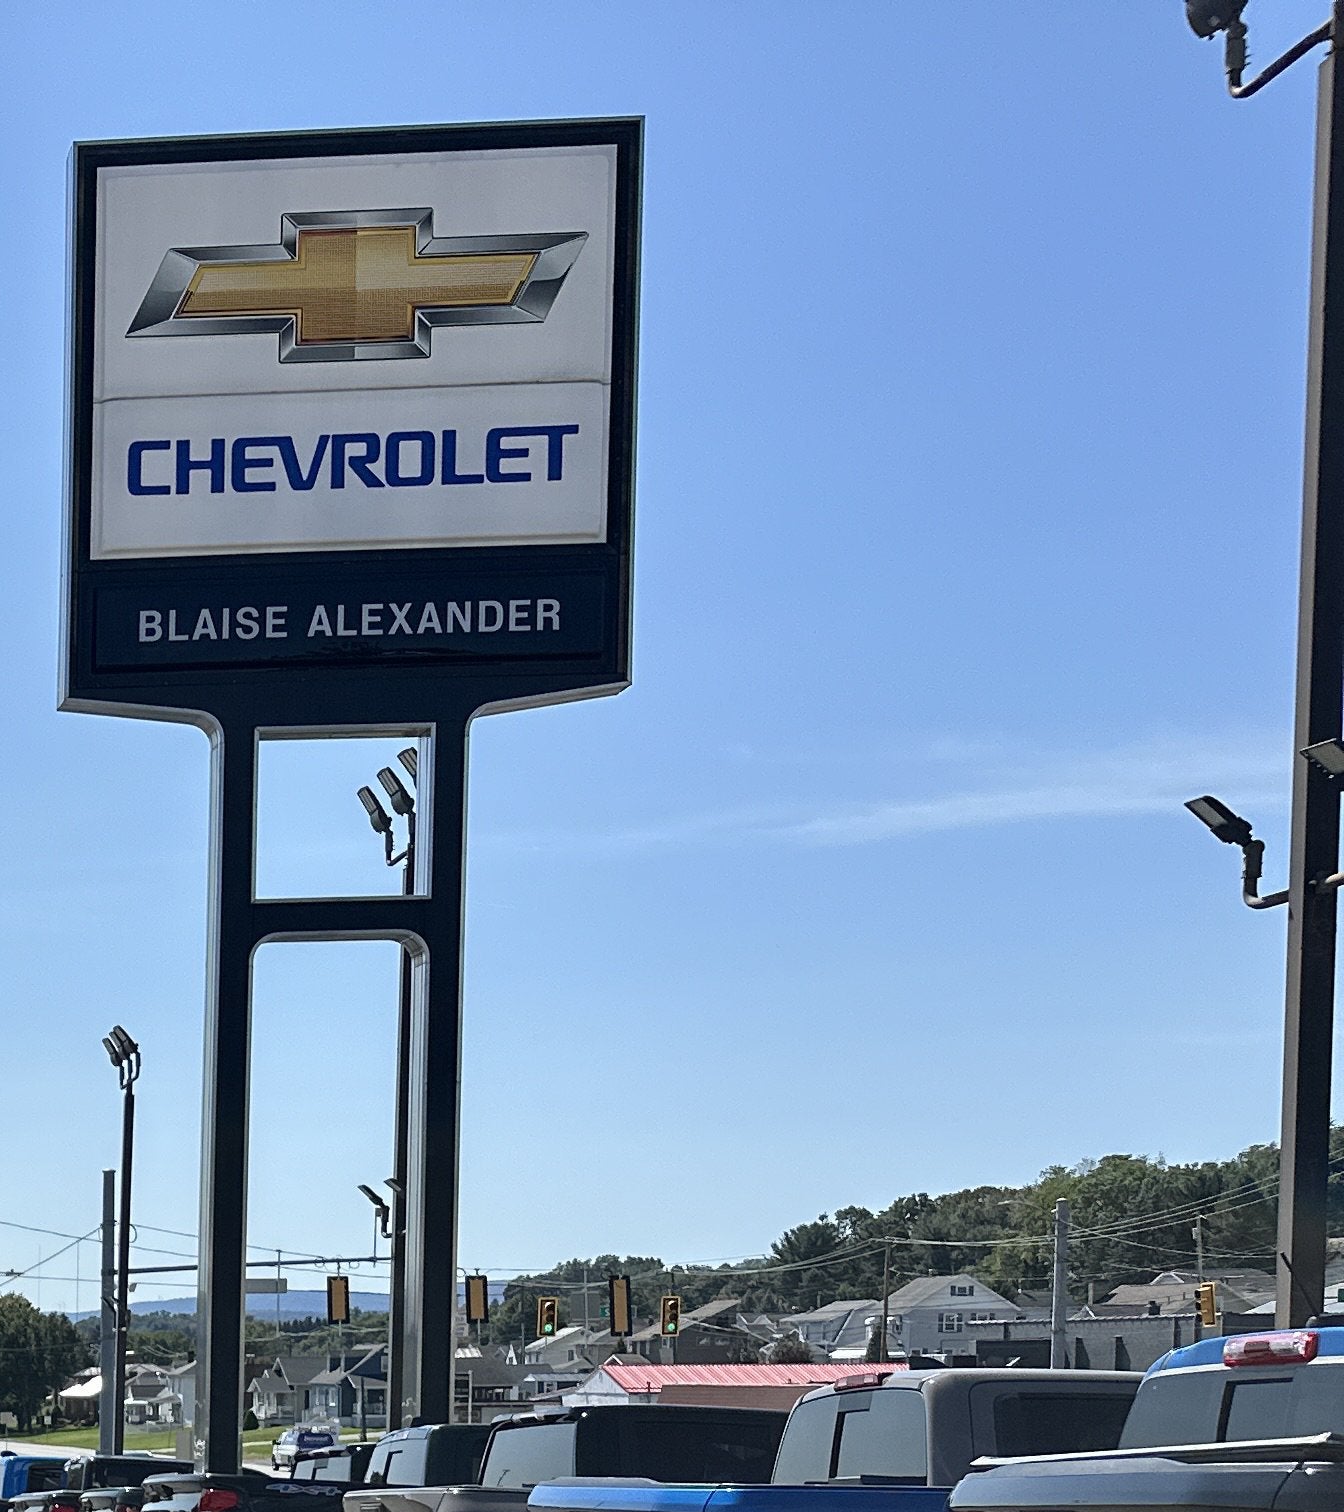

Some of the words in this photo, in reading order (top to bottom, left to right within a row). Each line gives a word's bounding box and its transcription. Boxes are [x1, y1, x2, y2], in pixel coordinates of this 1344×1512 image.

[127, 424, 579, 496] CHEVROLET
[138, 606, 288, 643] BLAISE
[307, 599, 561, 638] ALEXANDER
